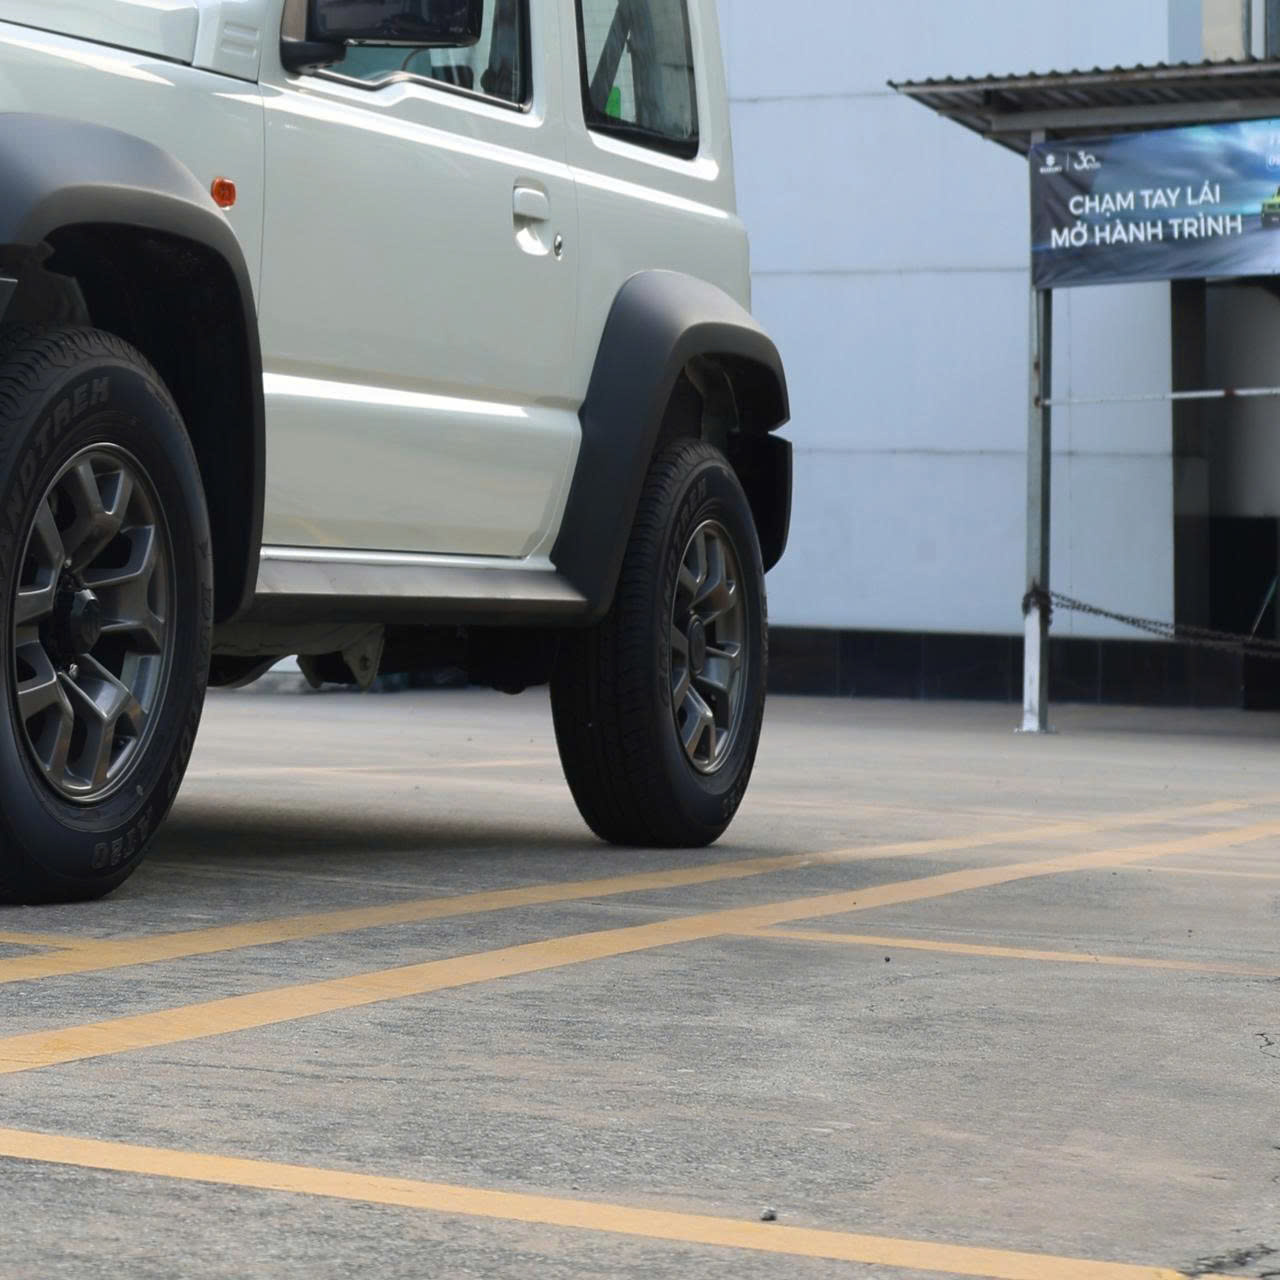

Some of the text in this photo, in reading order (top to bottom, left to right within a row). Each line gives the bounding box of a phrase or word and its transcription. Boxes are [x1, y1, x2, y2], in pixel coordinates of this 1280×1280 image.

[1069, 191, 1135, 217] CHẠM
[1140, 187, 1180, 209] TAY
[1050, 212, 1242, 249] MỞ HÀNH TRÌNH
